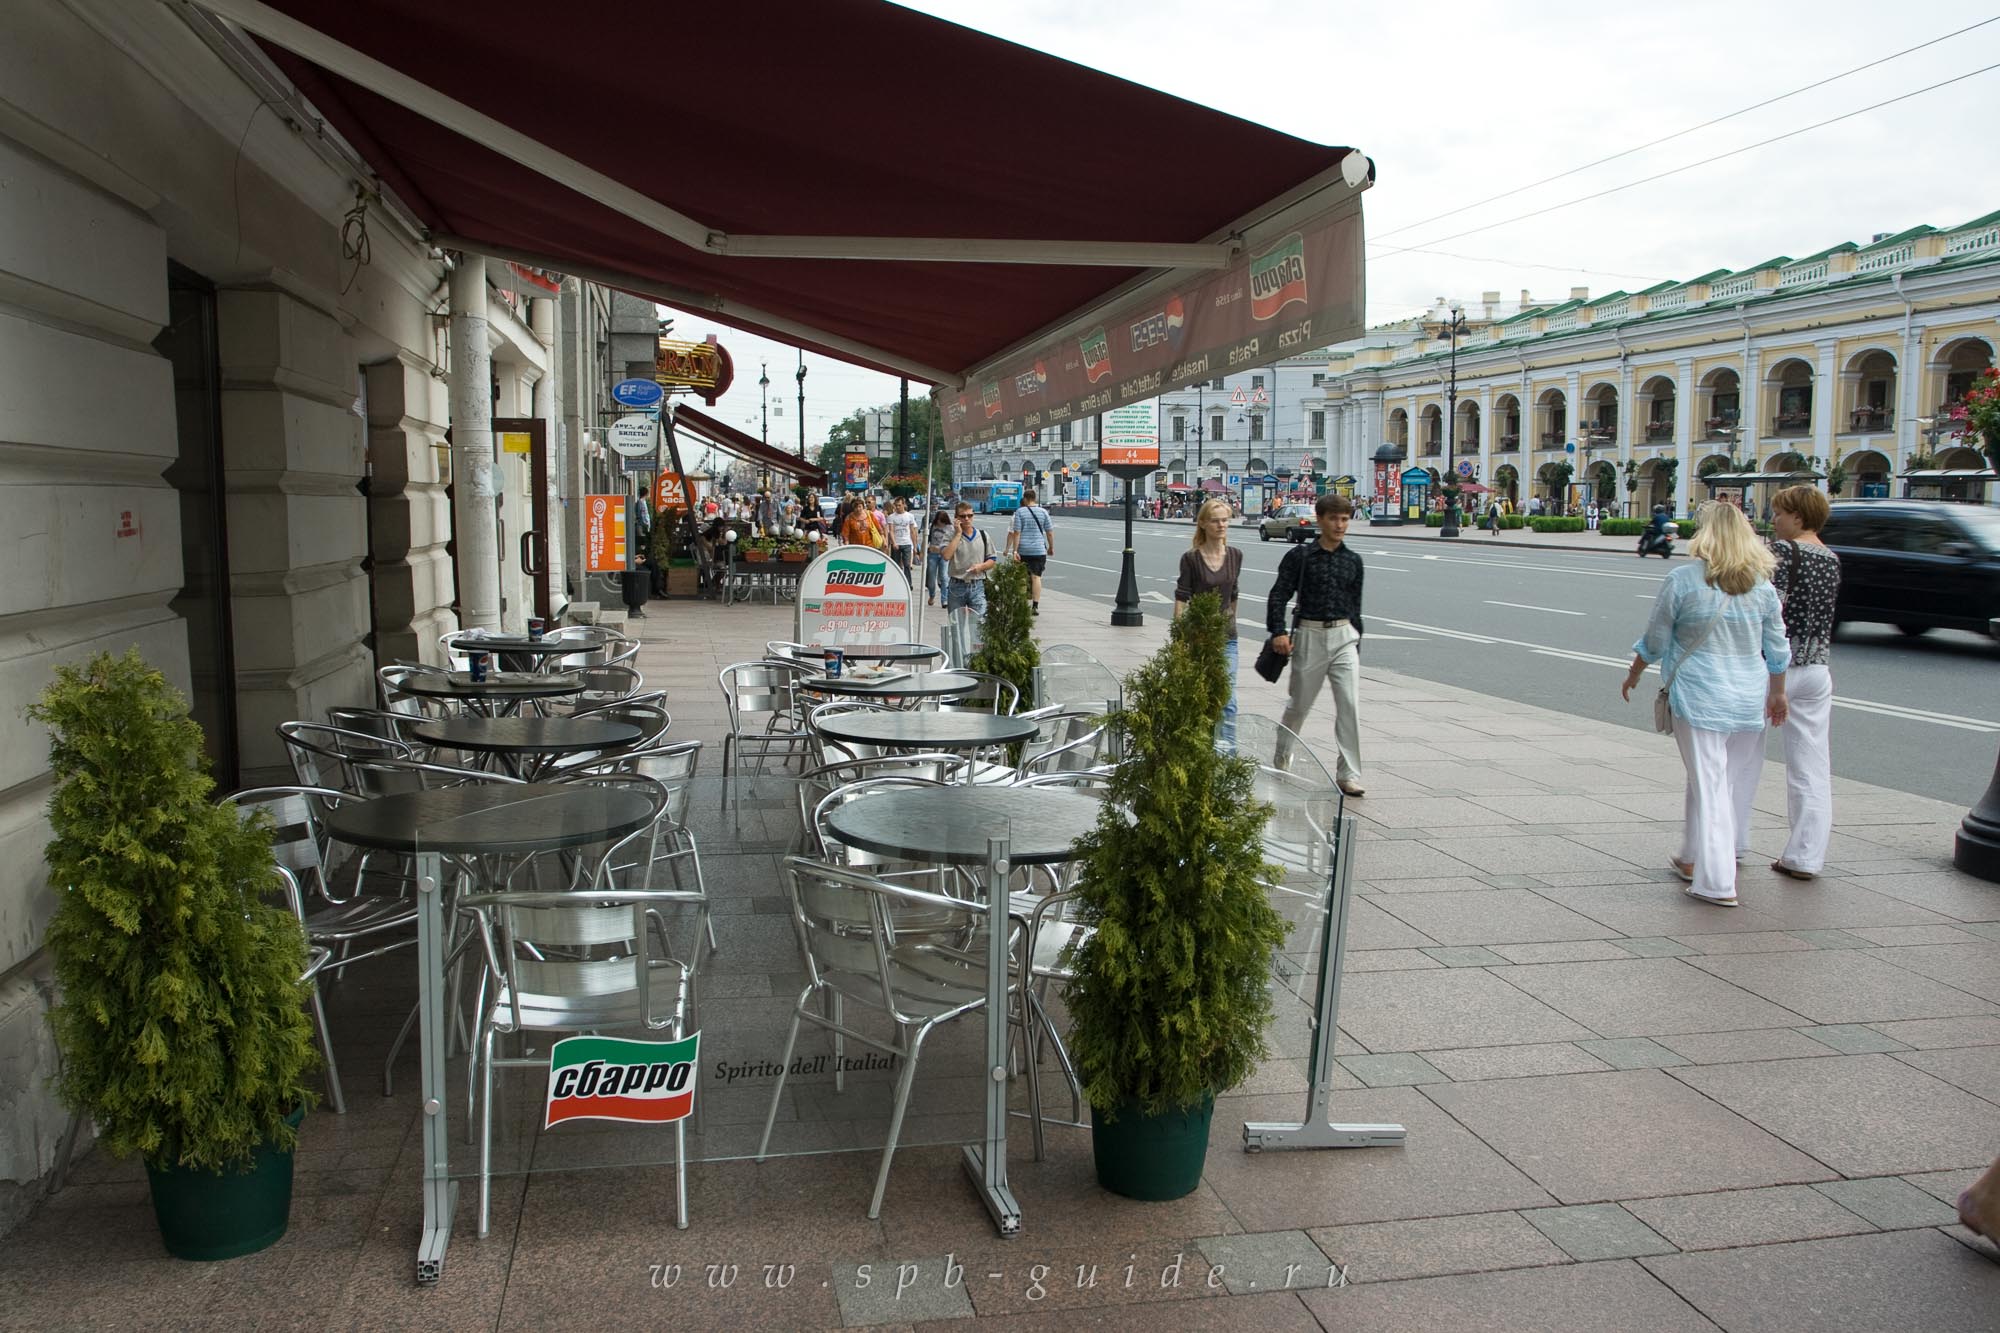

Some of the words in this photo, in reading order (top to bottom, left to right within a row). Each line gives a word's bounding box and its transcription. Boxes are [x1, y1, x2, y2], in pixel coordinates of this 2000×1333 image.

[620, 384, 637, 396] EF
[1126, 450, 1137, 458] 44
[661, 480, 686, 497] 24
[826, 569, 885, 585] сбарро
[822, 601, 906, 617] ЗАВТРАКИ
[715, 1061, 785, 1084] Spirito
[835, 1053, 897, 1073] Italia!
[553, 1060, 693, 1098] сбарро
